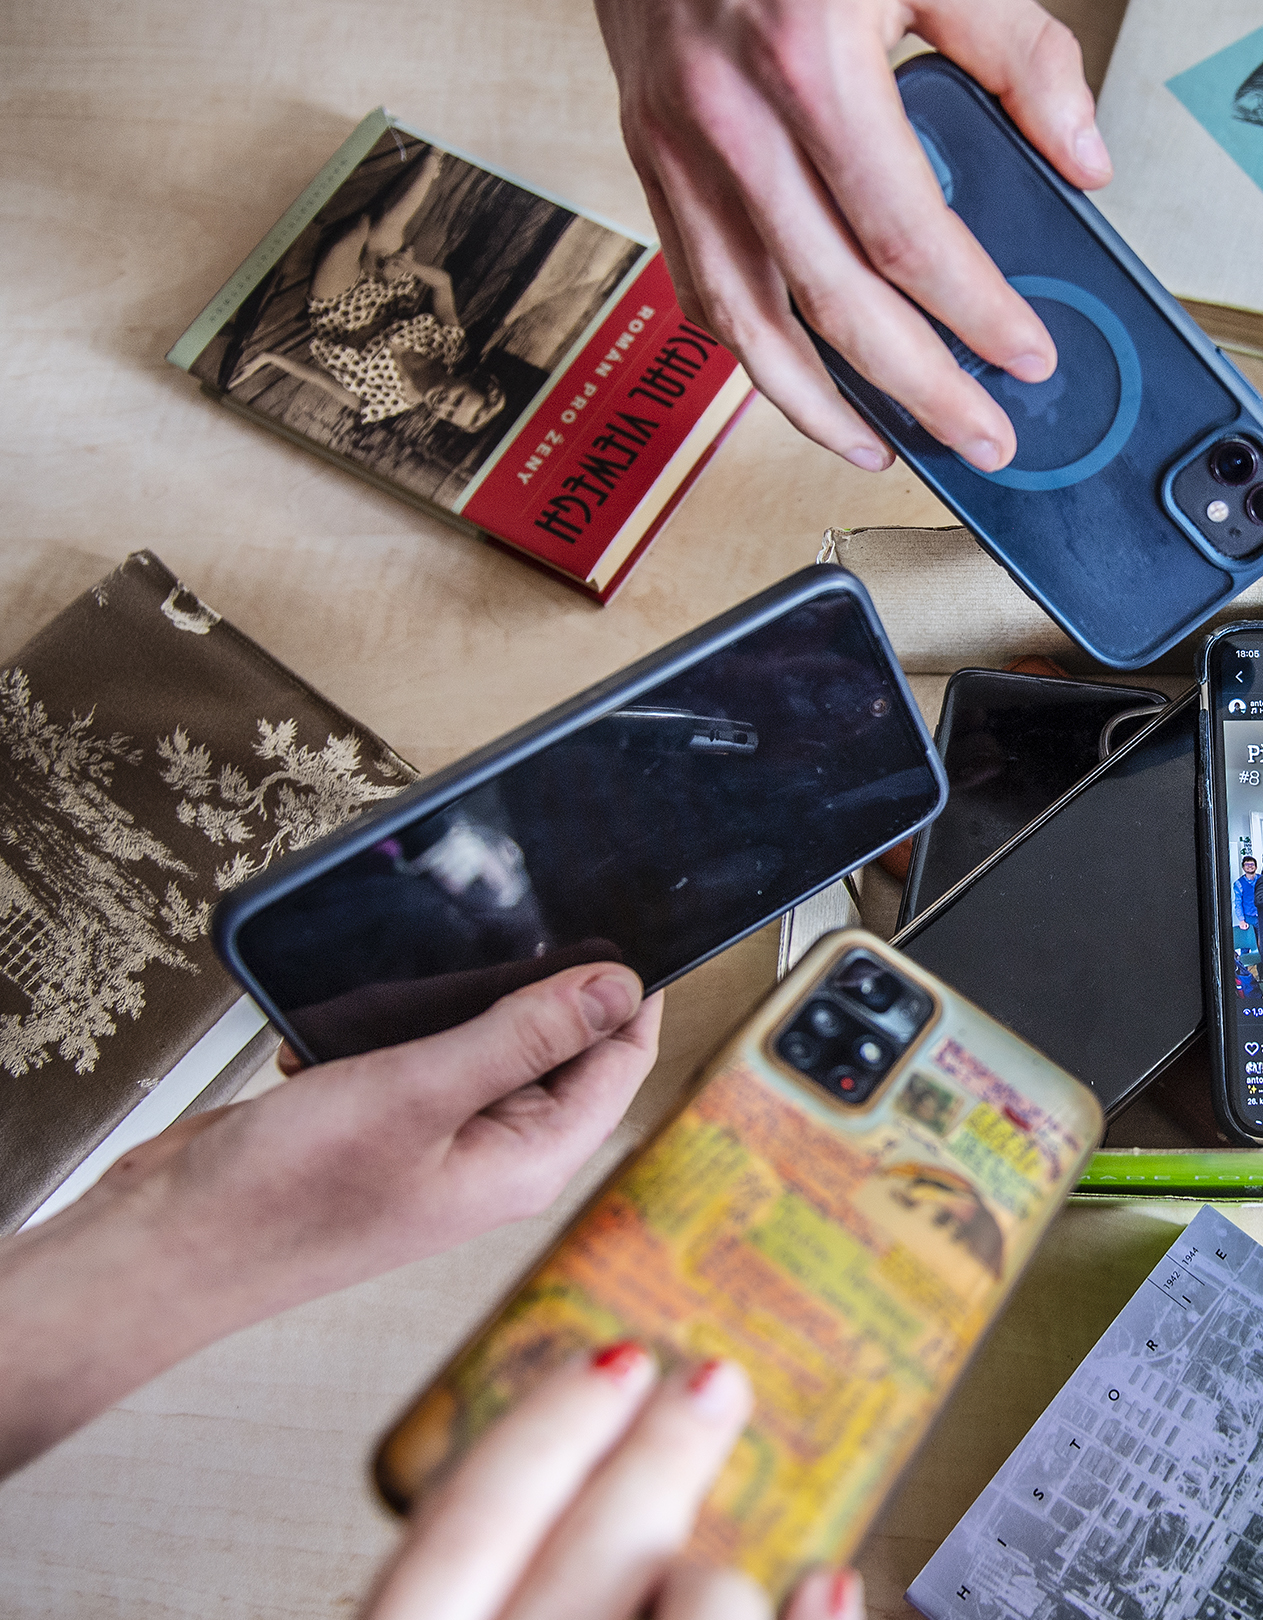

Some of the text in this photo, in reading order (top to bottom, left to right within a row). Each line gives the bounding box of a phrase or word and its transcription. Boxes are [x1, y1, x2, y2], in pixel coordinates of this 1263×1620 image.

[516, 304, 656, 486] ROMÁN PRO ŽENY
[533, 322, 719, 545] ICHAL VIEWEGH
[1235, 649, 1260, 658] 18:05
[1238, 770, 1260, 786] #8
[1252, 1007, 1263, 1017] 1,9
[1247, 1098, 1258, 1106] 26.
[1163, 1246, 1199, 1290] 1942 1944
